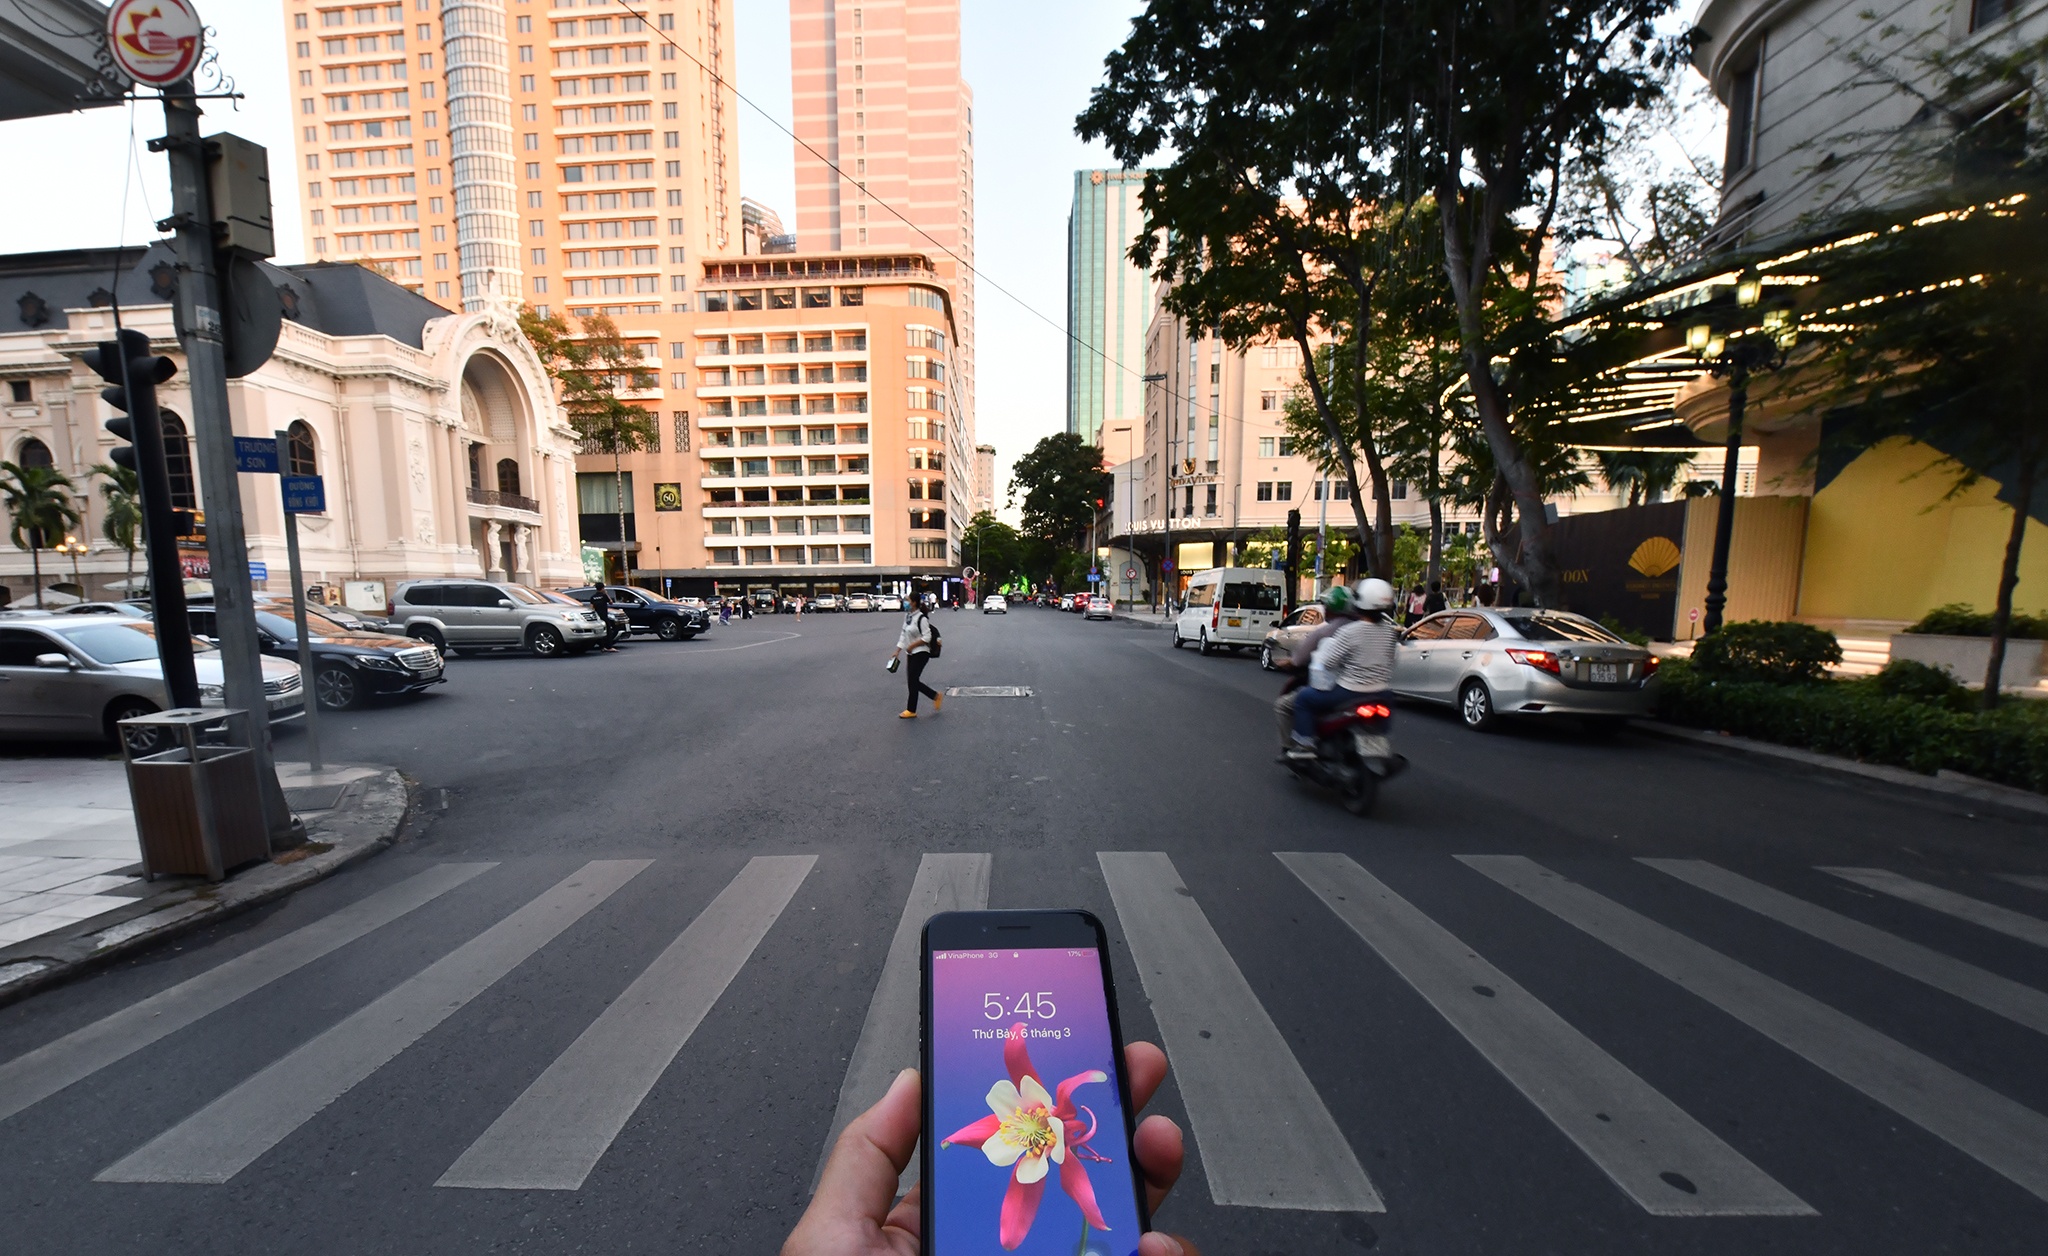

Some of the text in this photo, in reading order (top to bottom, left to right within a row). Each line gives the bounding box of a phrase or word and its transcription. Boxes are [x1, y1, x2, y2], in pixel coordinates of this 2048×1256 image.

[663, 492, 675, 502] 60
[1125, 518, 1201, 532] LOUIS VUTTON
[984, 992, 1056, 1020] 5:45
[972, 1027, 1071, 1040] Thứ Bảy, 6 tháng 3
